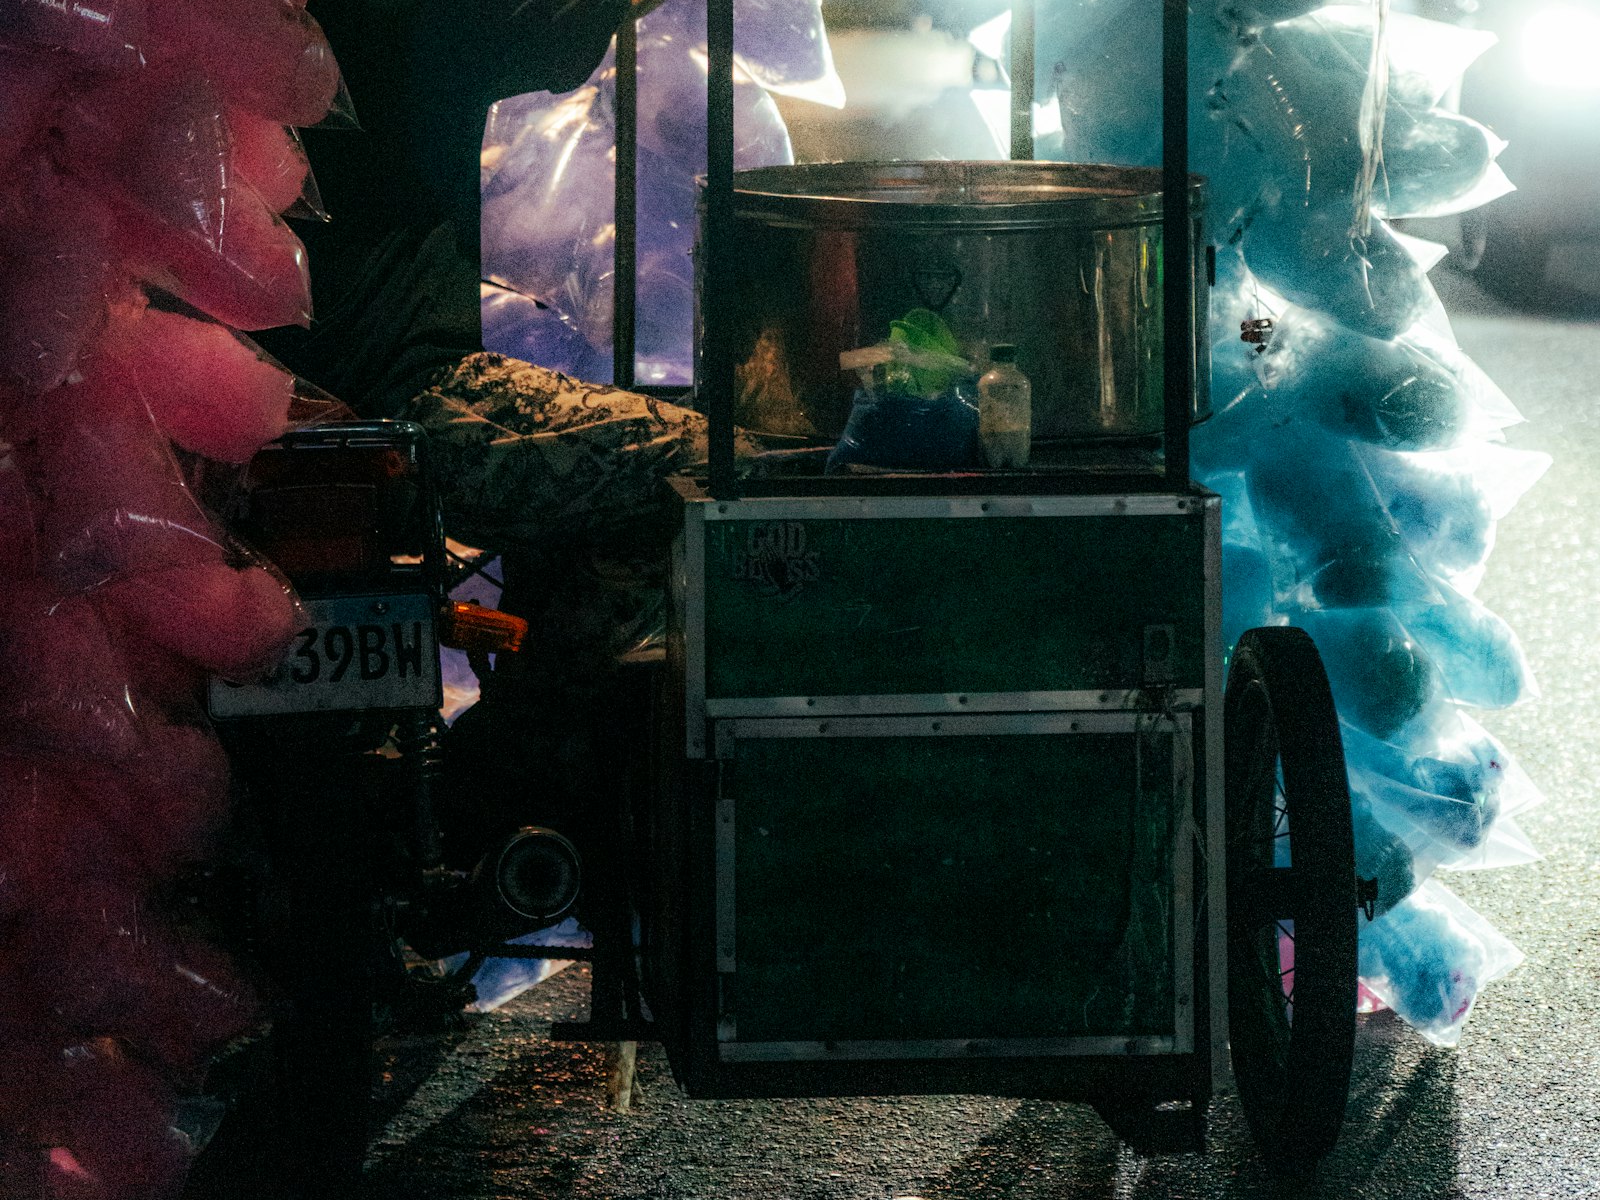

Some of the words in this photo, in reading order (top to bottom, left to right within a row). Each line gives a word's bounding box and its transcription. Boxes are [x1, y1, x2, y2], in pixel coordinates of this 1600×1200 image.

[747, 521, 807, 558] GOD
[731, 549, 821, 582] BLSS
[223, 621, 421, 687] 39BW
